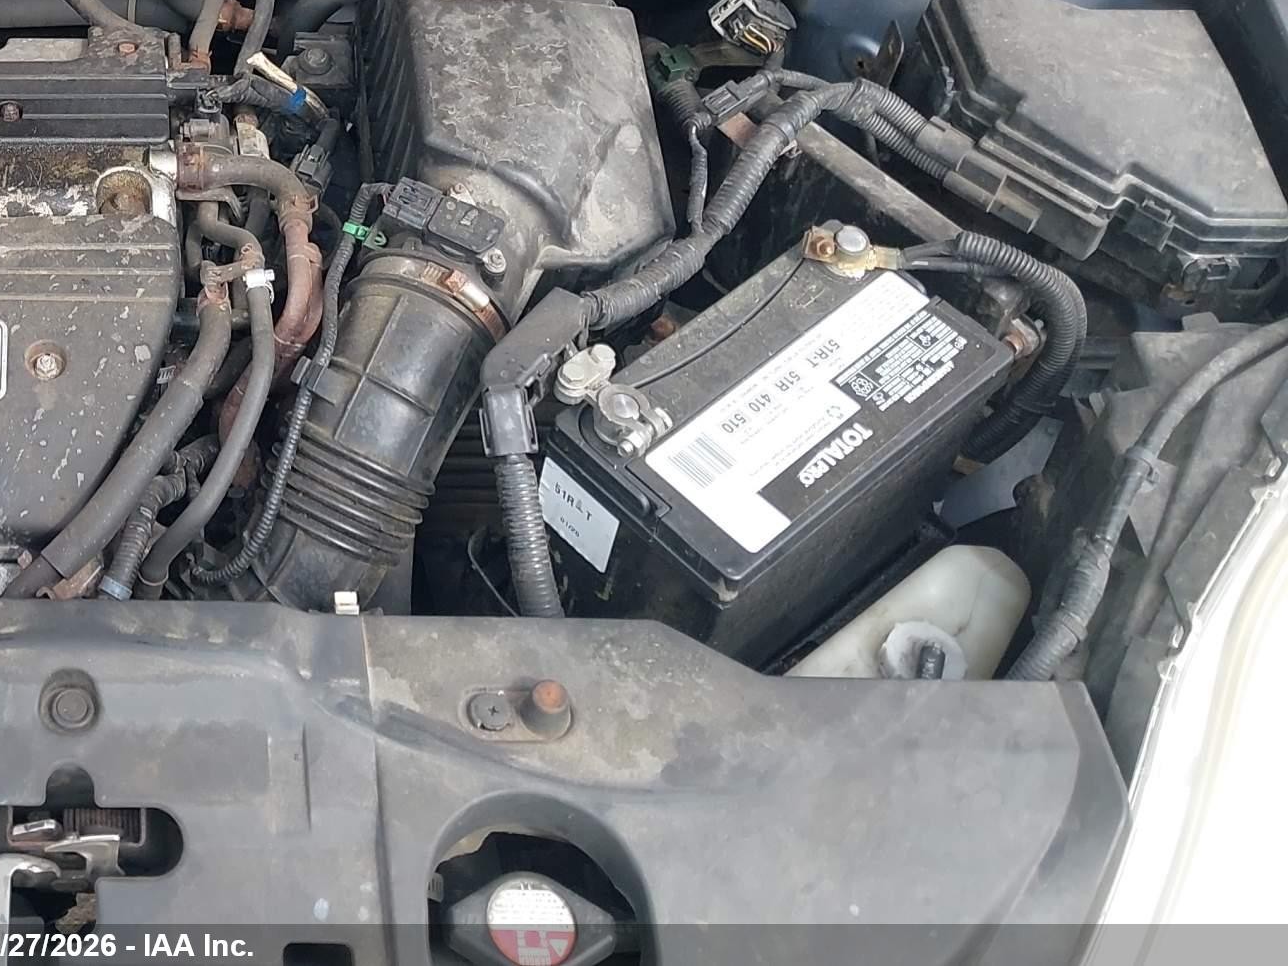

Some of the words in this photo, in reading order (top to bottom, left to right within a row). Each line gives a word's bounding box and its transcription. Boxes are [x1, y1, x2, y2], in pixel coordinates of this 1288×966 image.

[775, 370, 801, 392] 51R
[748, 393, 771, 413] 410
[721, 413, 747, 434] 510
[798, 422, 874, 487] TOTALPRO
